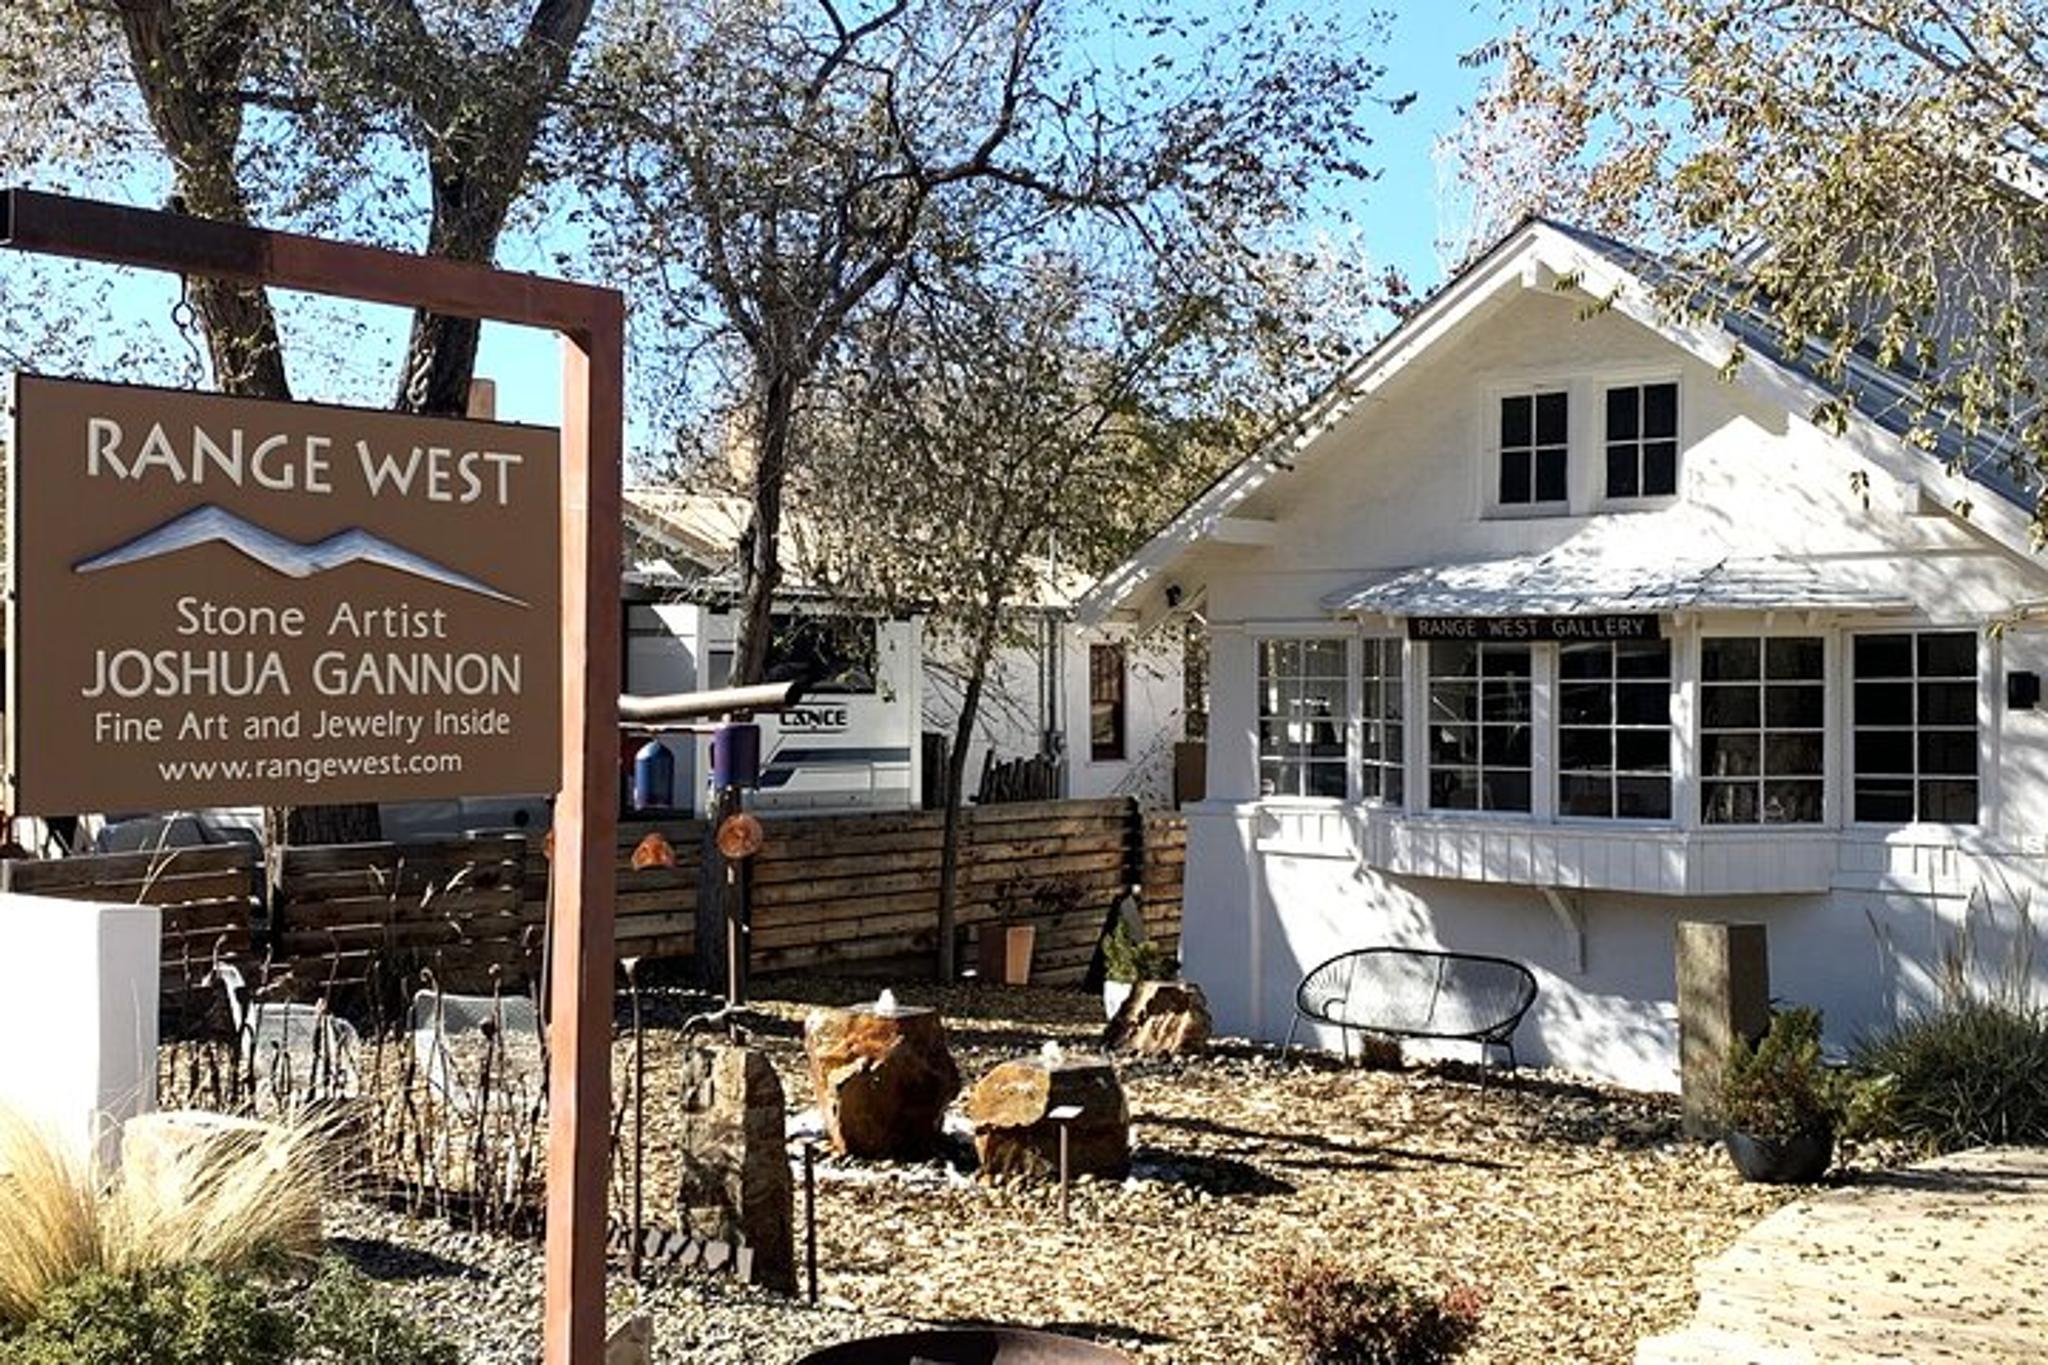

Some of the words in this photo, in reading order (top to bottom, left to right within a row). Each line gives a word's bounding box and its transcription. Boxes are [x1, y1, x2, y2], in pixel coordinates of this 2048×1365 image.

[86, 417, 332, 494] RANGE
[356, 440, 524, 505] WEST
[176, 596, 304, 637] Stone
[327, 601, 448, 639] Artist
[1418, 619, 1477, 637] RANGE
[1488, 619, 1538, 637] WEST
[1552, 618, 1645, 637] GALLERY
[82, 649, 290, 698] JOSHUA
[313, 653, 522, 696] GANNON
[95, 712, 163, 742] Fine
[178, 713, 229, 741] Art
[244, 711, 300, 740] and
[313, 708, 424, 745] Jewelry
[434, 708, 511, 736] Inside
[158, 752, 463, 783] www.rangewest.com
